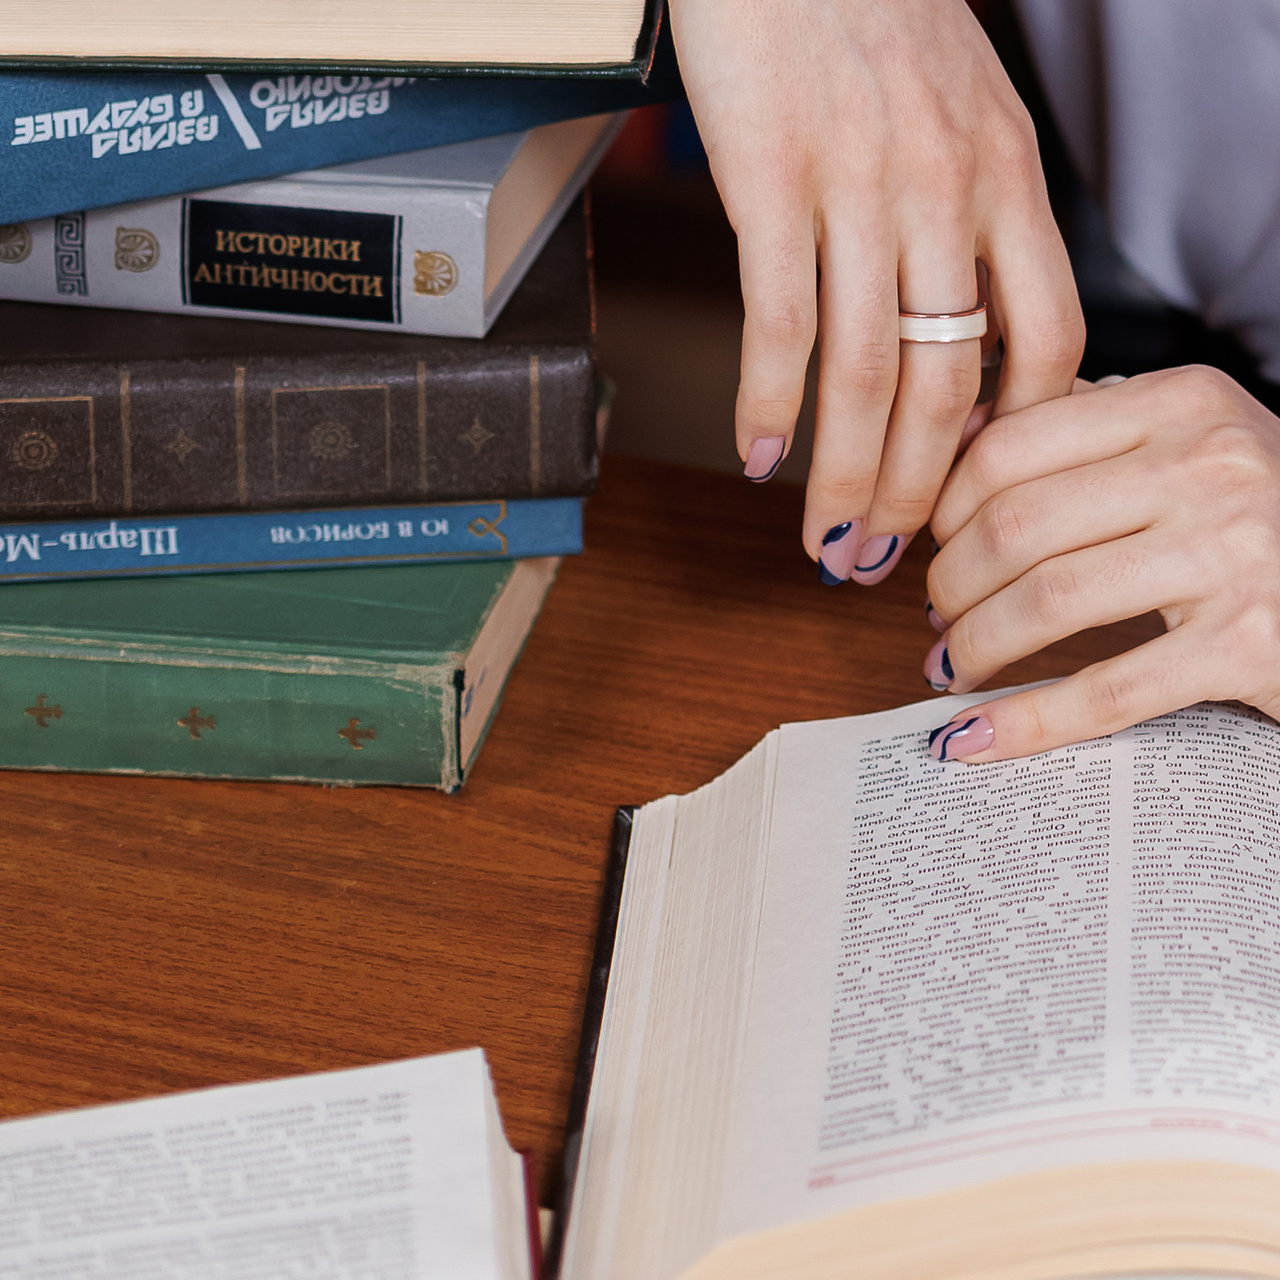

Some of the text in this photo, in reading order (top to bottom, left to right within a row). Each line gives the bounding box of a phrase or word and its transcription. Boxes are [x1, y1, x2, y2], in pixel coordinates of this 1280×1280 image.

[10, 89, 204, 146] В БУДУЩЕЕ
[265, 90, 389, 132] ВЗГЛЯД
[91, 114, 219, 159] ВЗГЛЯД
[215, 229, 361, 262] ИСТОРИКИ
[193, 262, 384, 297] АНТИЧНОСТИ
[270, 522, 389, 544] БОРИСОВ
[1176, 754, 1234, 764] истории
[1005, 764, 1076, 784] восточных
[1075, 767, 1112, 777] ского
[855, 756, 1076, 804] Иван III действительно много
[999, 783, 1064, 801] спасшего
[1133, 795, 1180, 803] борьбу
[1179, 787, 1280, 809] действительно
[924, 794, 973, 807] приняв
[938, 799, 988, 813] Европу
[852, 783, 1111, 837] торическую миссию русского на-
[854, 811, 884, 821] себя
[913, 810, 928, 818] от
[851, 791, 1111, 845] точно характеризует великую ис-
[852, 815, 902, 829] ордын-
[1032, 813, 1078, 826] провел
[1078, 817, 1110, 827] ской
[1133, 812, 1242, 823] социально-эко-
[976, 822, 994, 830] же
[995, 825, 1016, 834] эту
[1215, 823, 1254, 835] князя
[924, 828, 964, 840] время
[944, 833, 979, 844] идею
[980, 829, 1082, 853] независимость
[1047, 834, 1110, 848] сословия
[850, 838, 912, 854] писатель
[892, 844, 928, 855] через
[919, 845, 962, 858] может
[1004, 848, 1021, 856] их
[1079, 843, 1110, 851] ское
[850, 854, 876, 863] всю
[918, 854, 996, 874] отношении
[932, 852, 966, 863] Руси
[981, 851, 1052, 869] население
[843, 851, 1109, 906] пытался отделить простое москов-
[848, 868, 891, 880] татар-
[843, 876, 892, 890] борьбе
[843, 879, 914, 898] боярского
